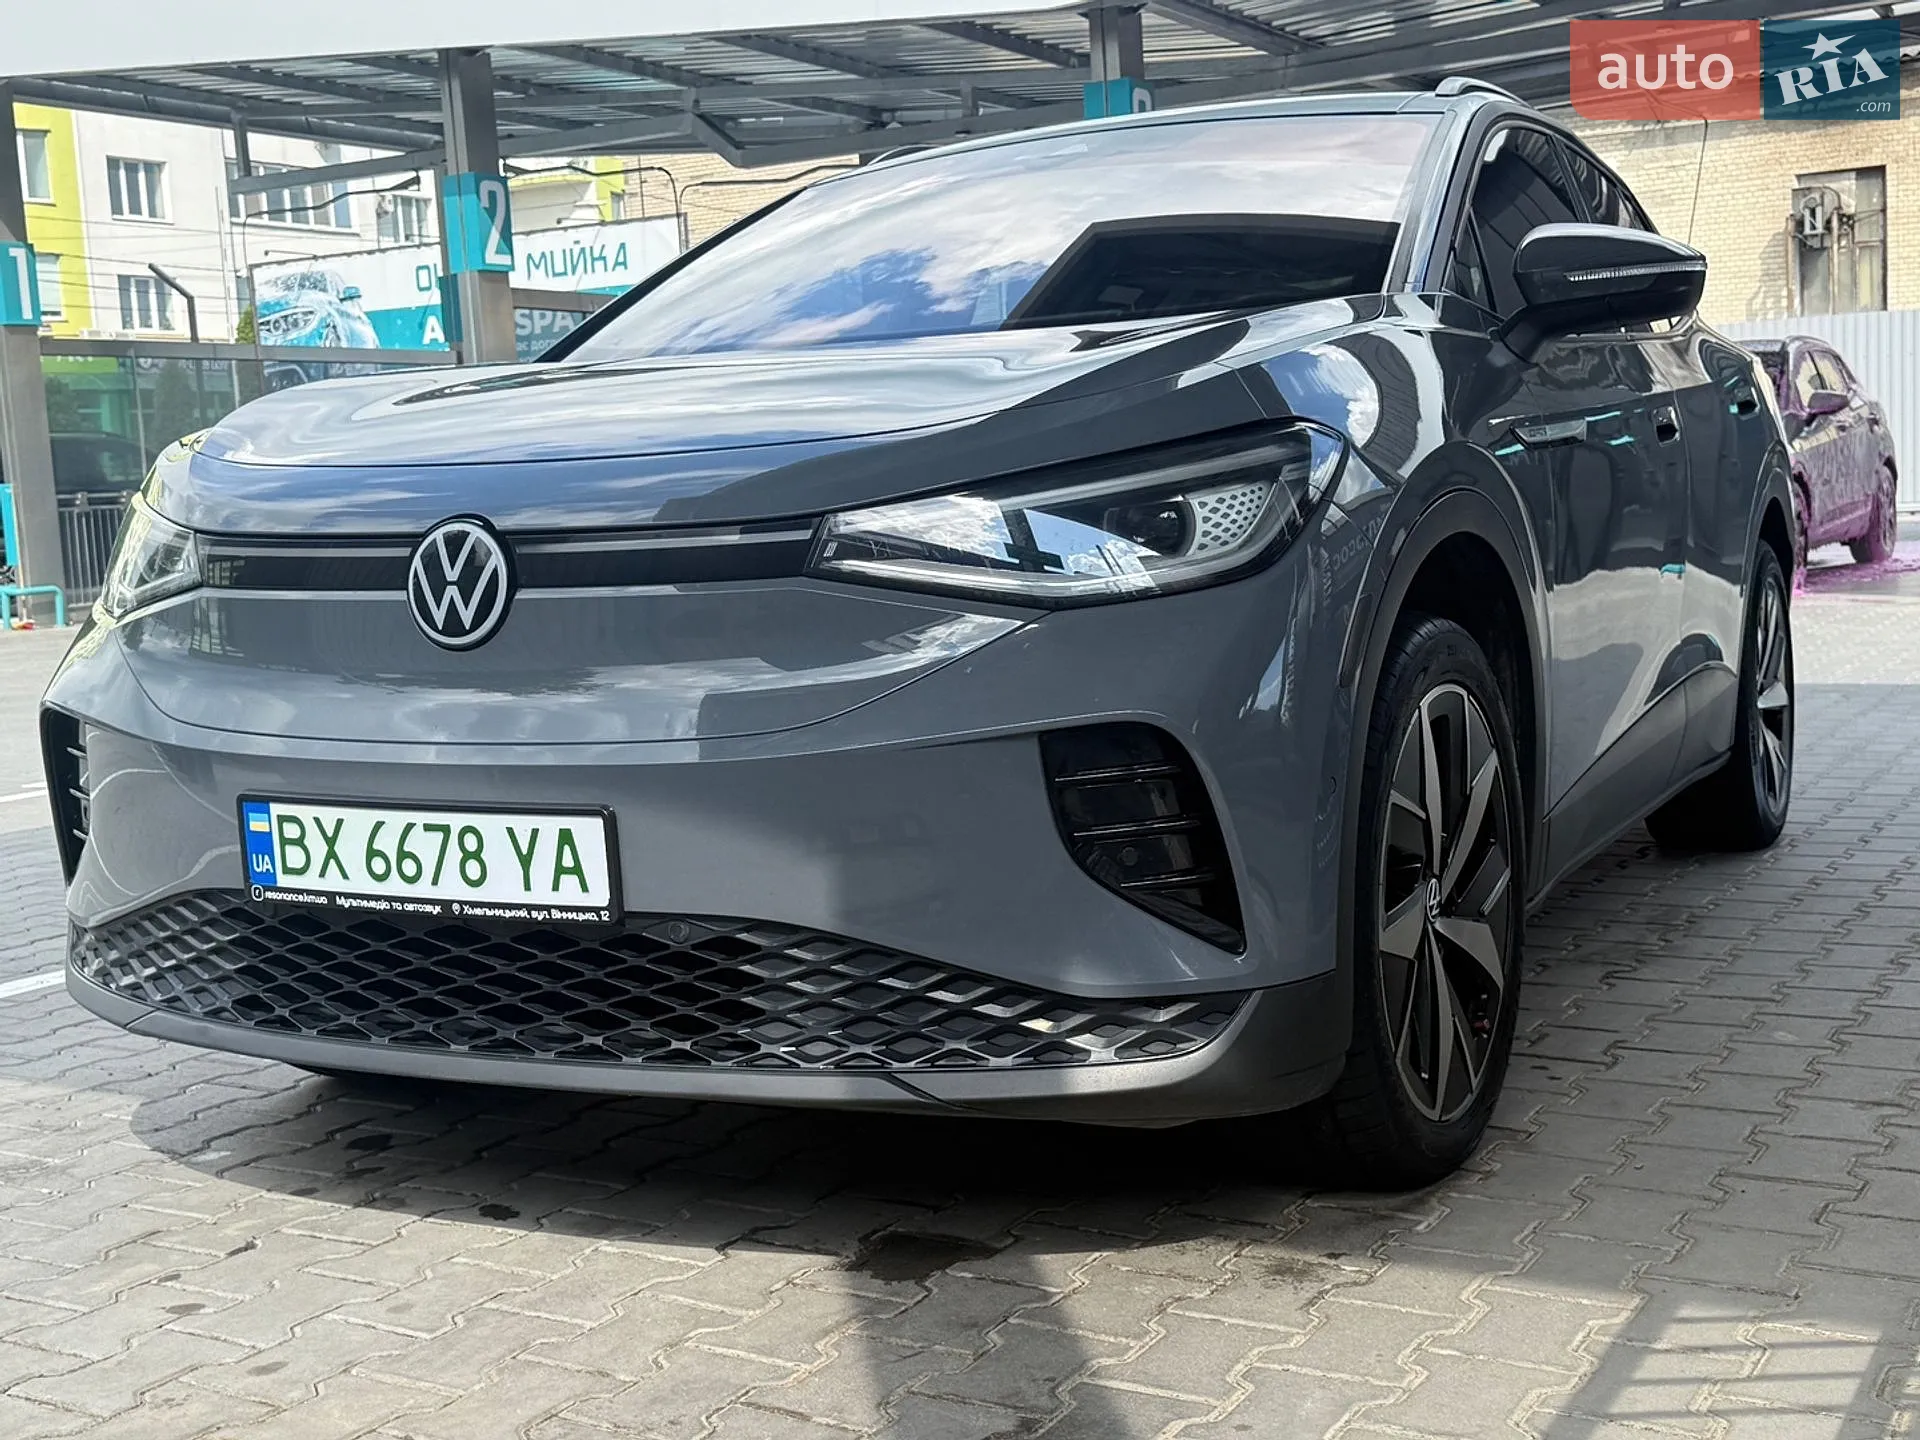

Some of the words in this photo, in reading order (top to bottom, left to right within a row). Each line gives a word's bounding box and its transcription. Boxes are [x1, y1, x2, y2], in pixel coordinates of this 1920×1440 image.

[479, 180, 512, 265] 2
[526, 240, 629, 281] МИЙКА
[8, 247, 34, 320] 1
[514, 308, 577, 336] SPA
[252, 853, 274, 874] UA
[277, 814, 349, 880] BX
[364, 820, 488, 888] 6678
[506, 827, 590, 893] YA
[600, 910, 611, 921] 12
